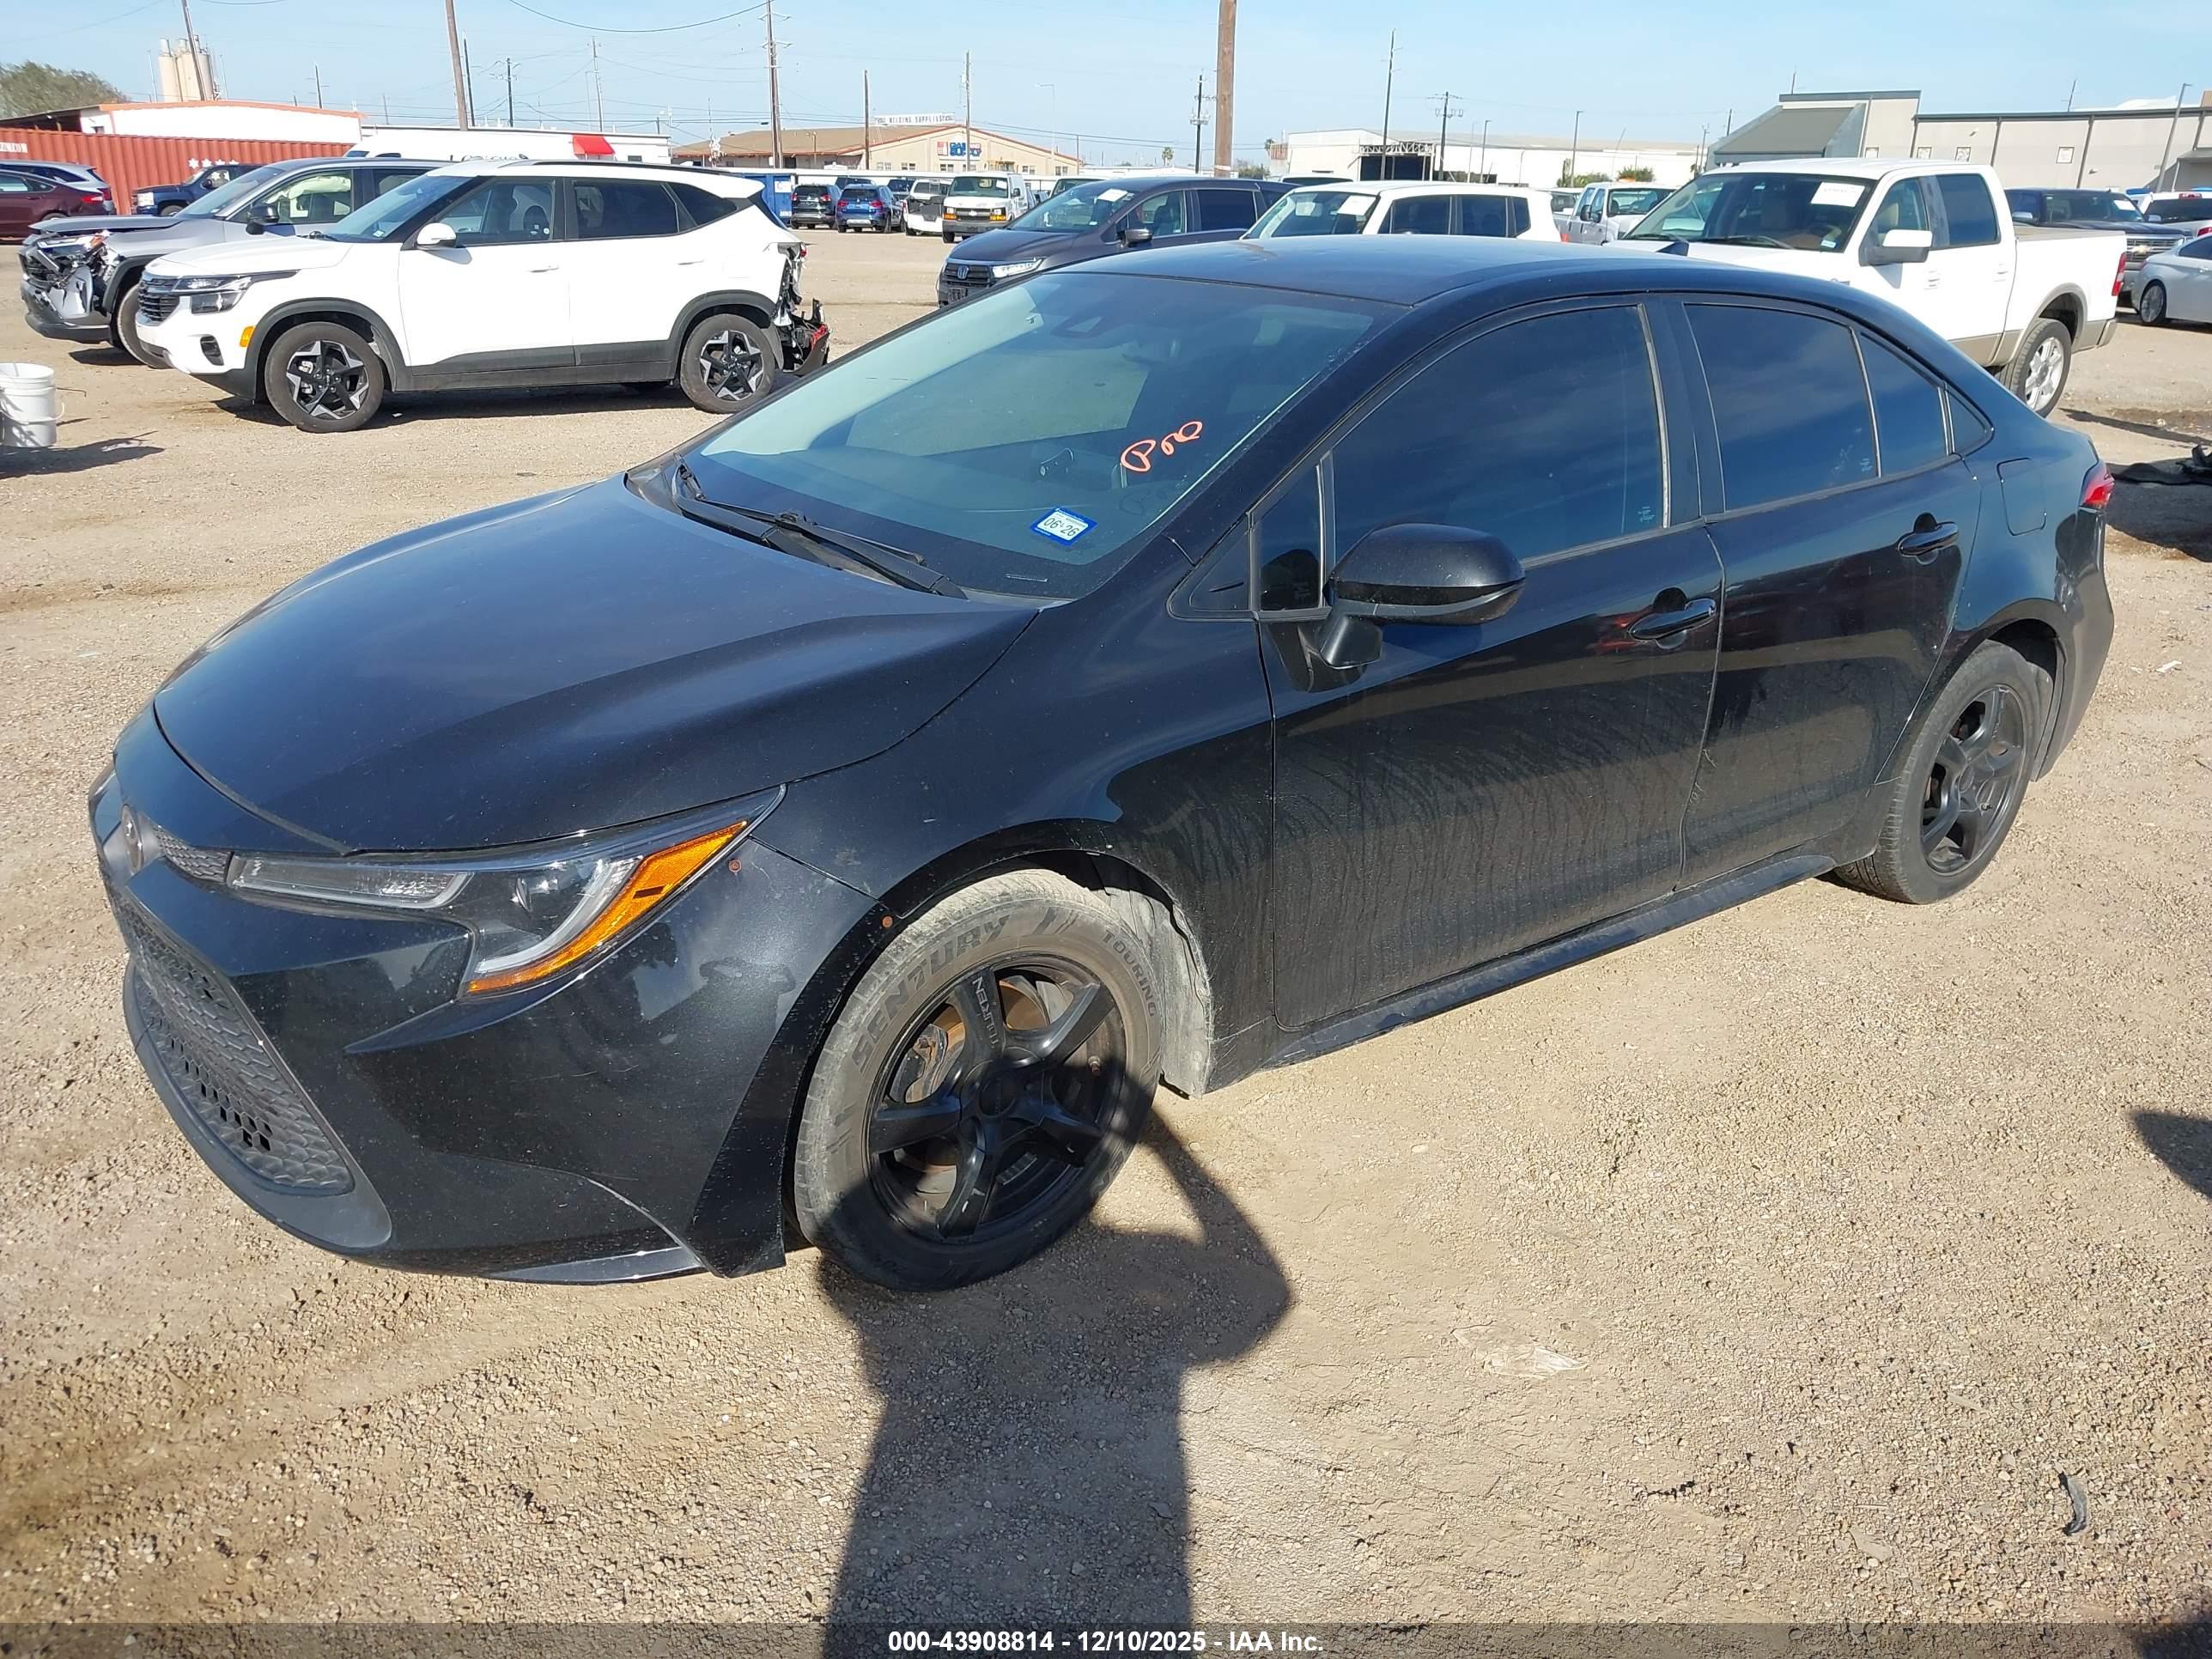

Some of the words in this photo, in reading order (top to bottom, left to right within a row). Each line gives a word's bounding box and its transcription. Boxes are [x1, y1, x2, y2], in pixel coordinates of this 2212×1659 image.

[1044, 518, 1061, 529] 06
[1060, 525, 1079, 537] 26
[851, 912, 1012, 1073] SENTURY
[1102, 933, 1156, 1018] TOURING
